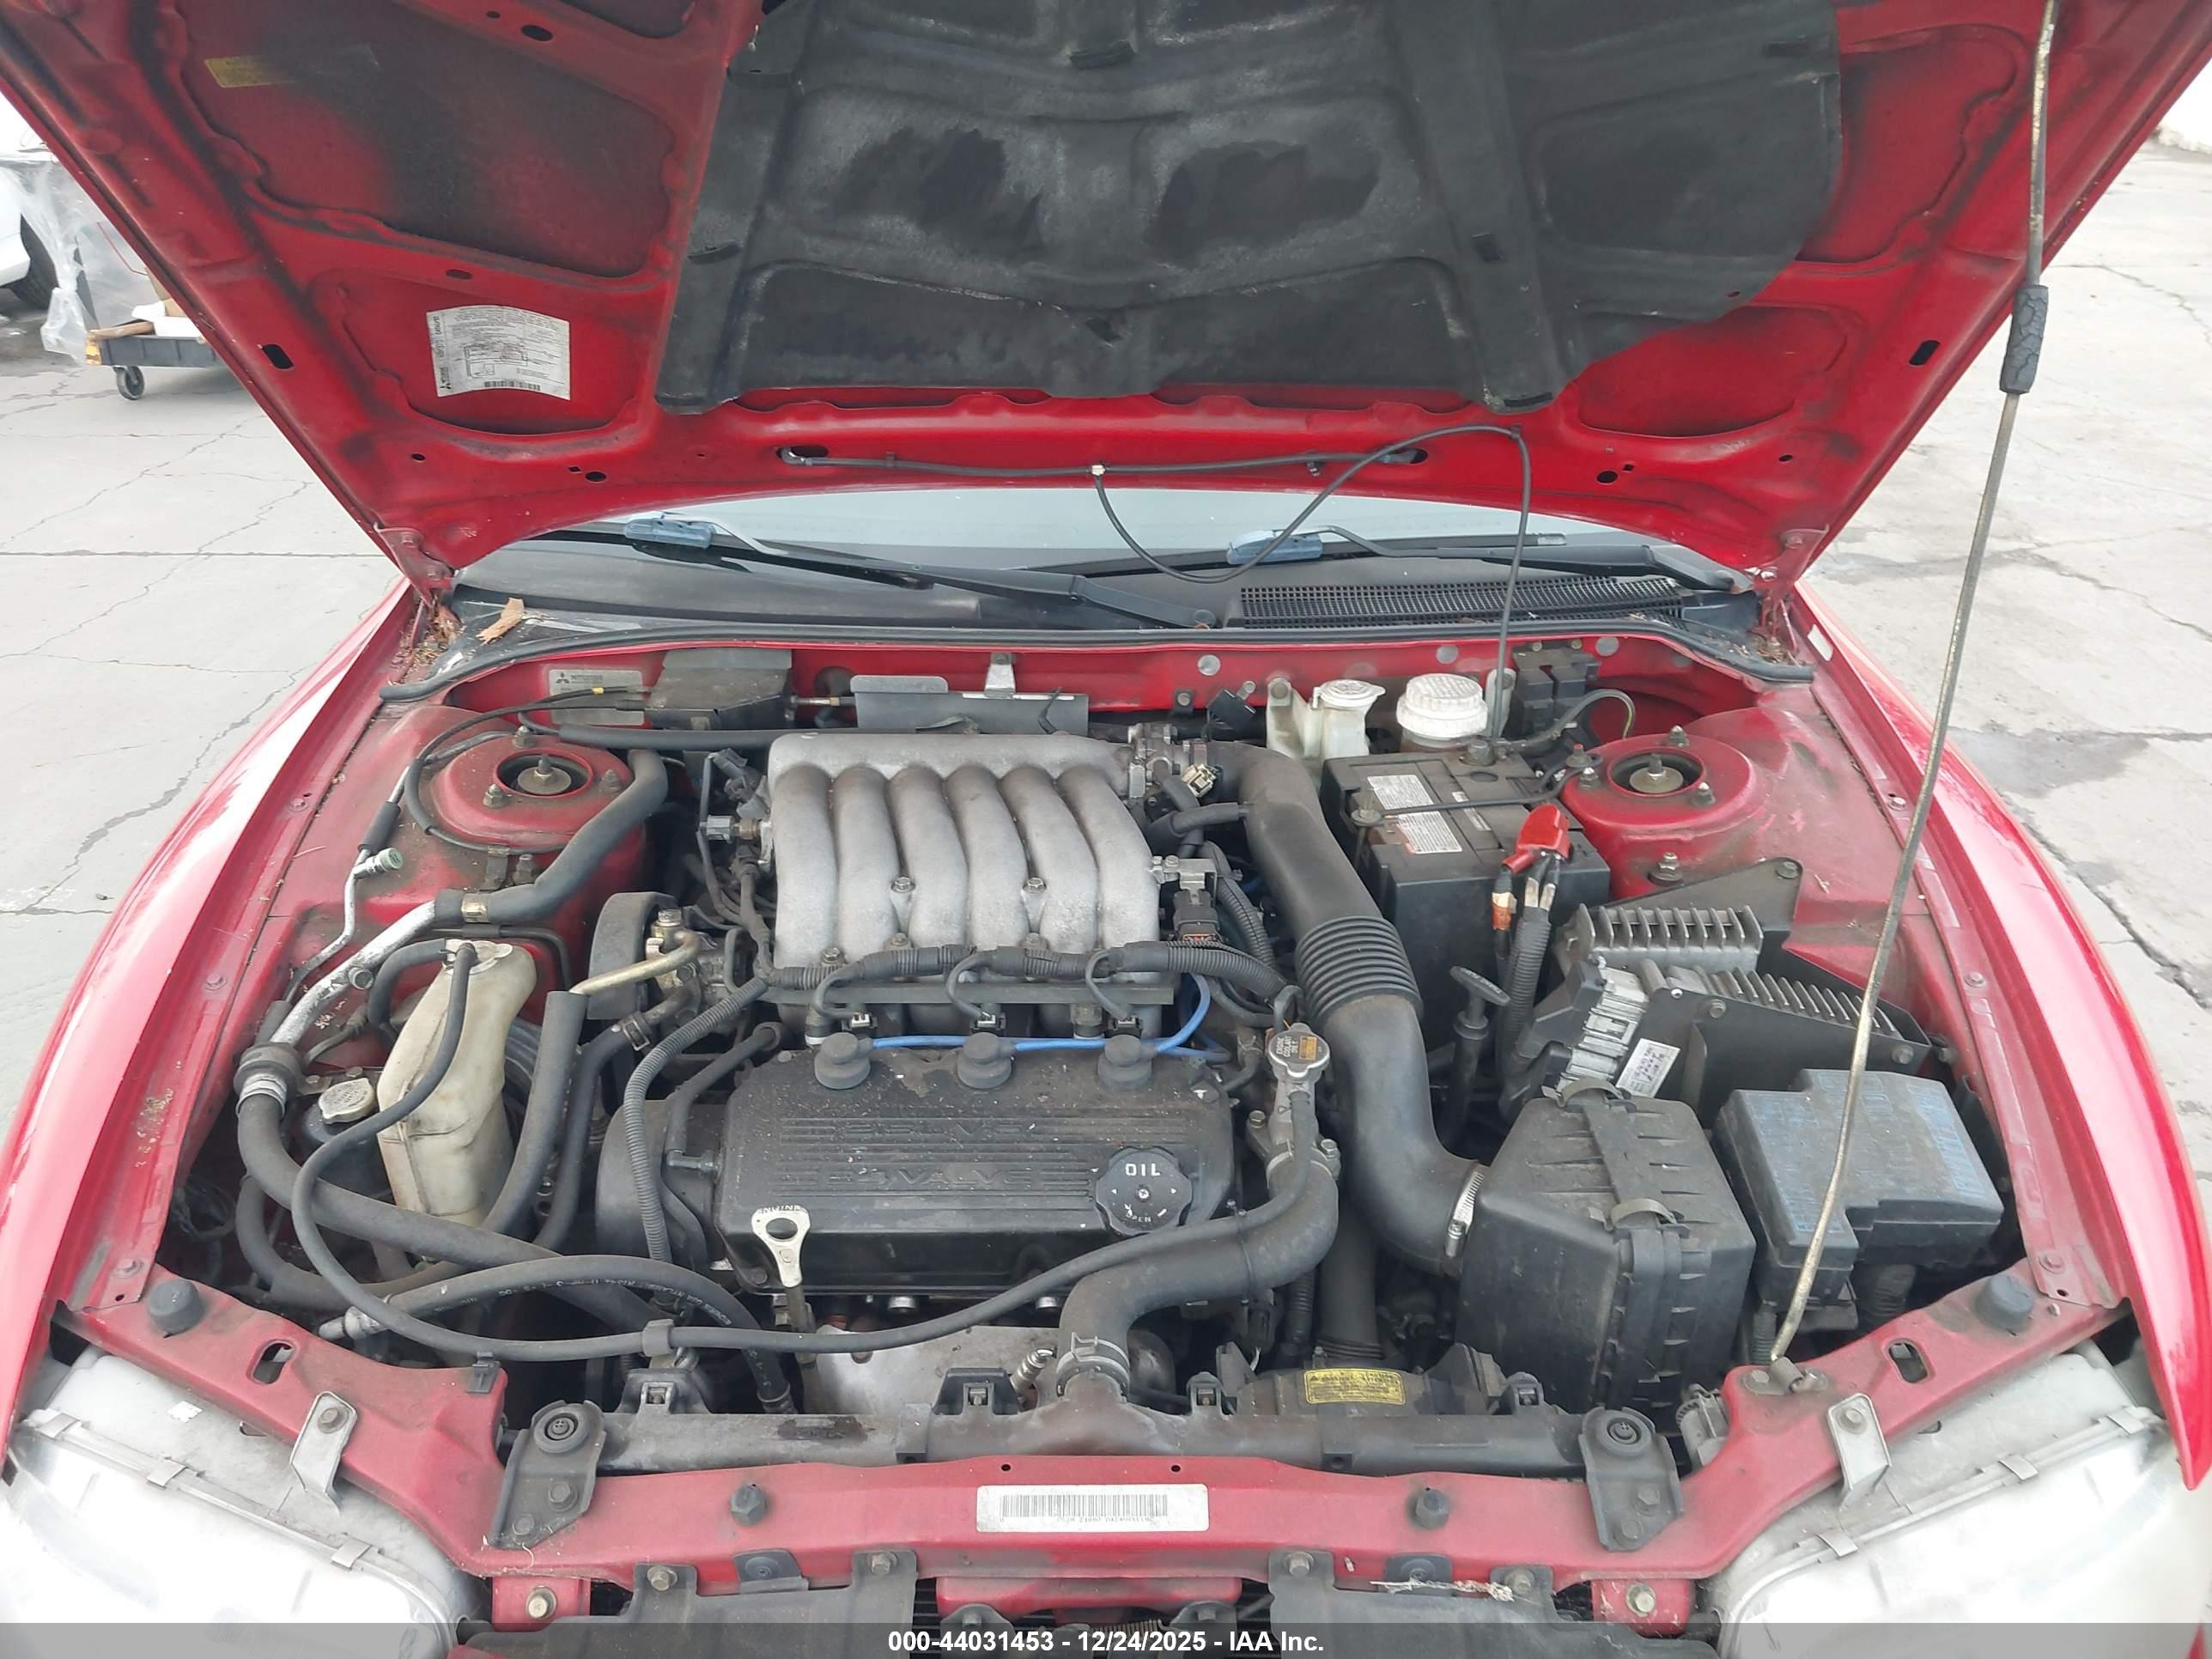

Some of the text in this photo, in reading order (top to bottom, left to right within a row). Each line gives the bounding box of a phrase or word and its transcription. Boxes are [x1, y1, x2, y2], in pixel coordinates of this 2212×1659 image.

[1283, 1036, 1291, 1057] COOLANT
[1125, 1163, 1161, 1176] OIL
[1126, 1212, 1152, 1223] OPEN
